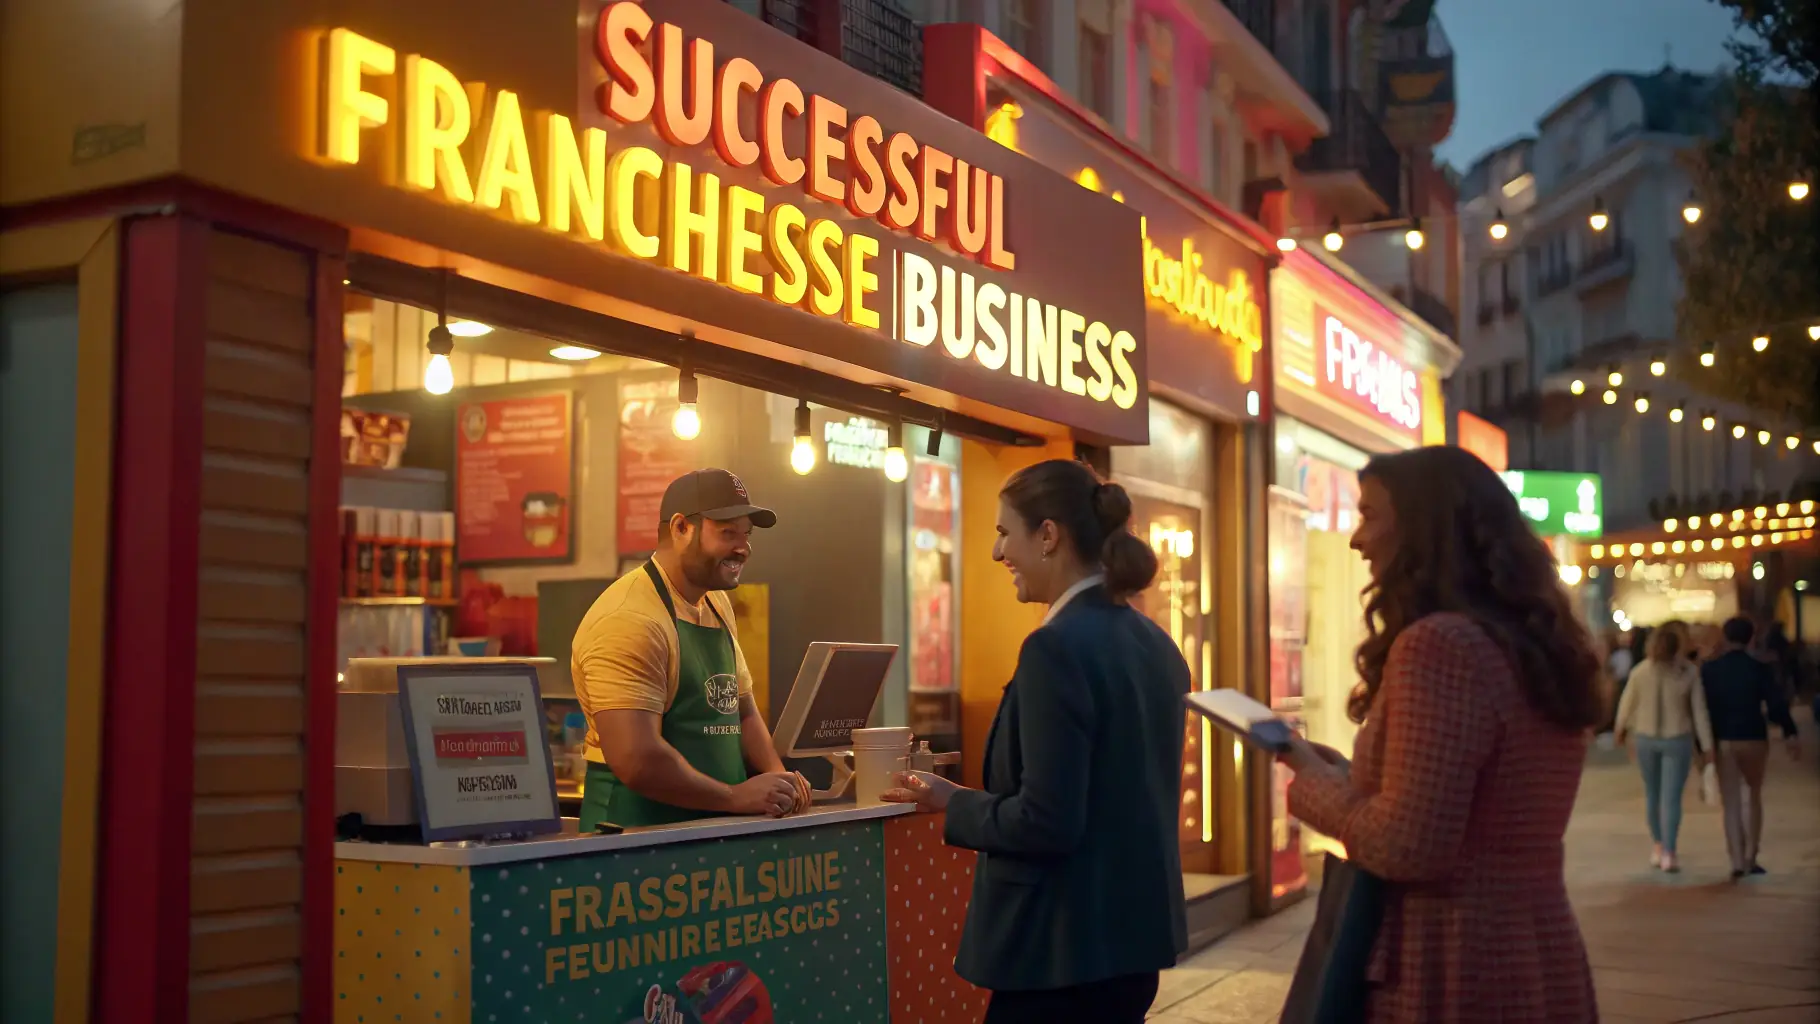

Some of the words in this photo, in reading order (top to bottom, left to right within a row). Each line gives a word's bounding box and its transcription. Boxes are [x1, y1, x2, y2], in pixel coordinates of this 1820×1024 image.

[322, 26, 880, 330] FRANCHESSE
[902, 250, 1138, 410] BUSINESS
[596, 1, 1015, 271] SUCCESSFUL
